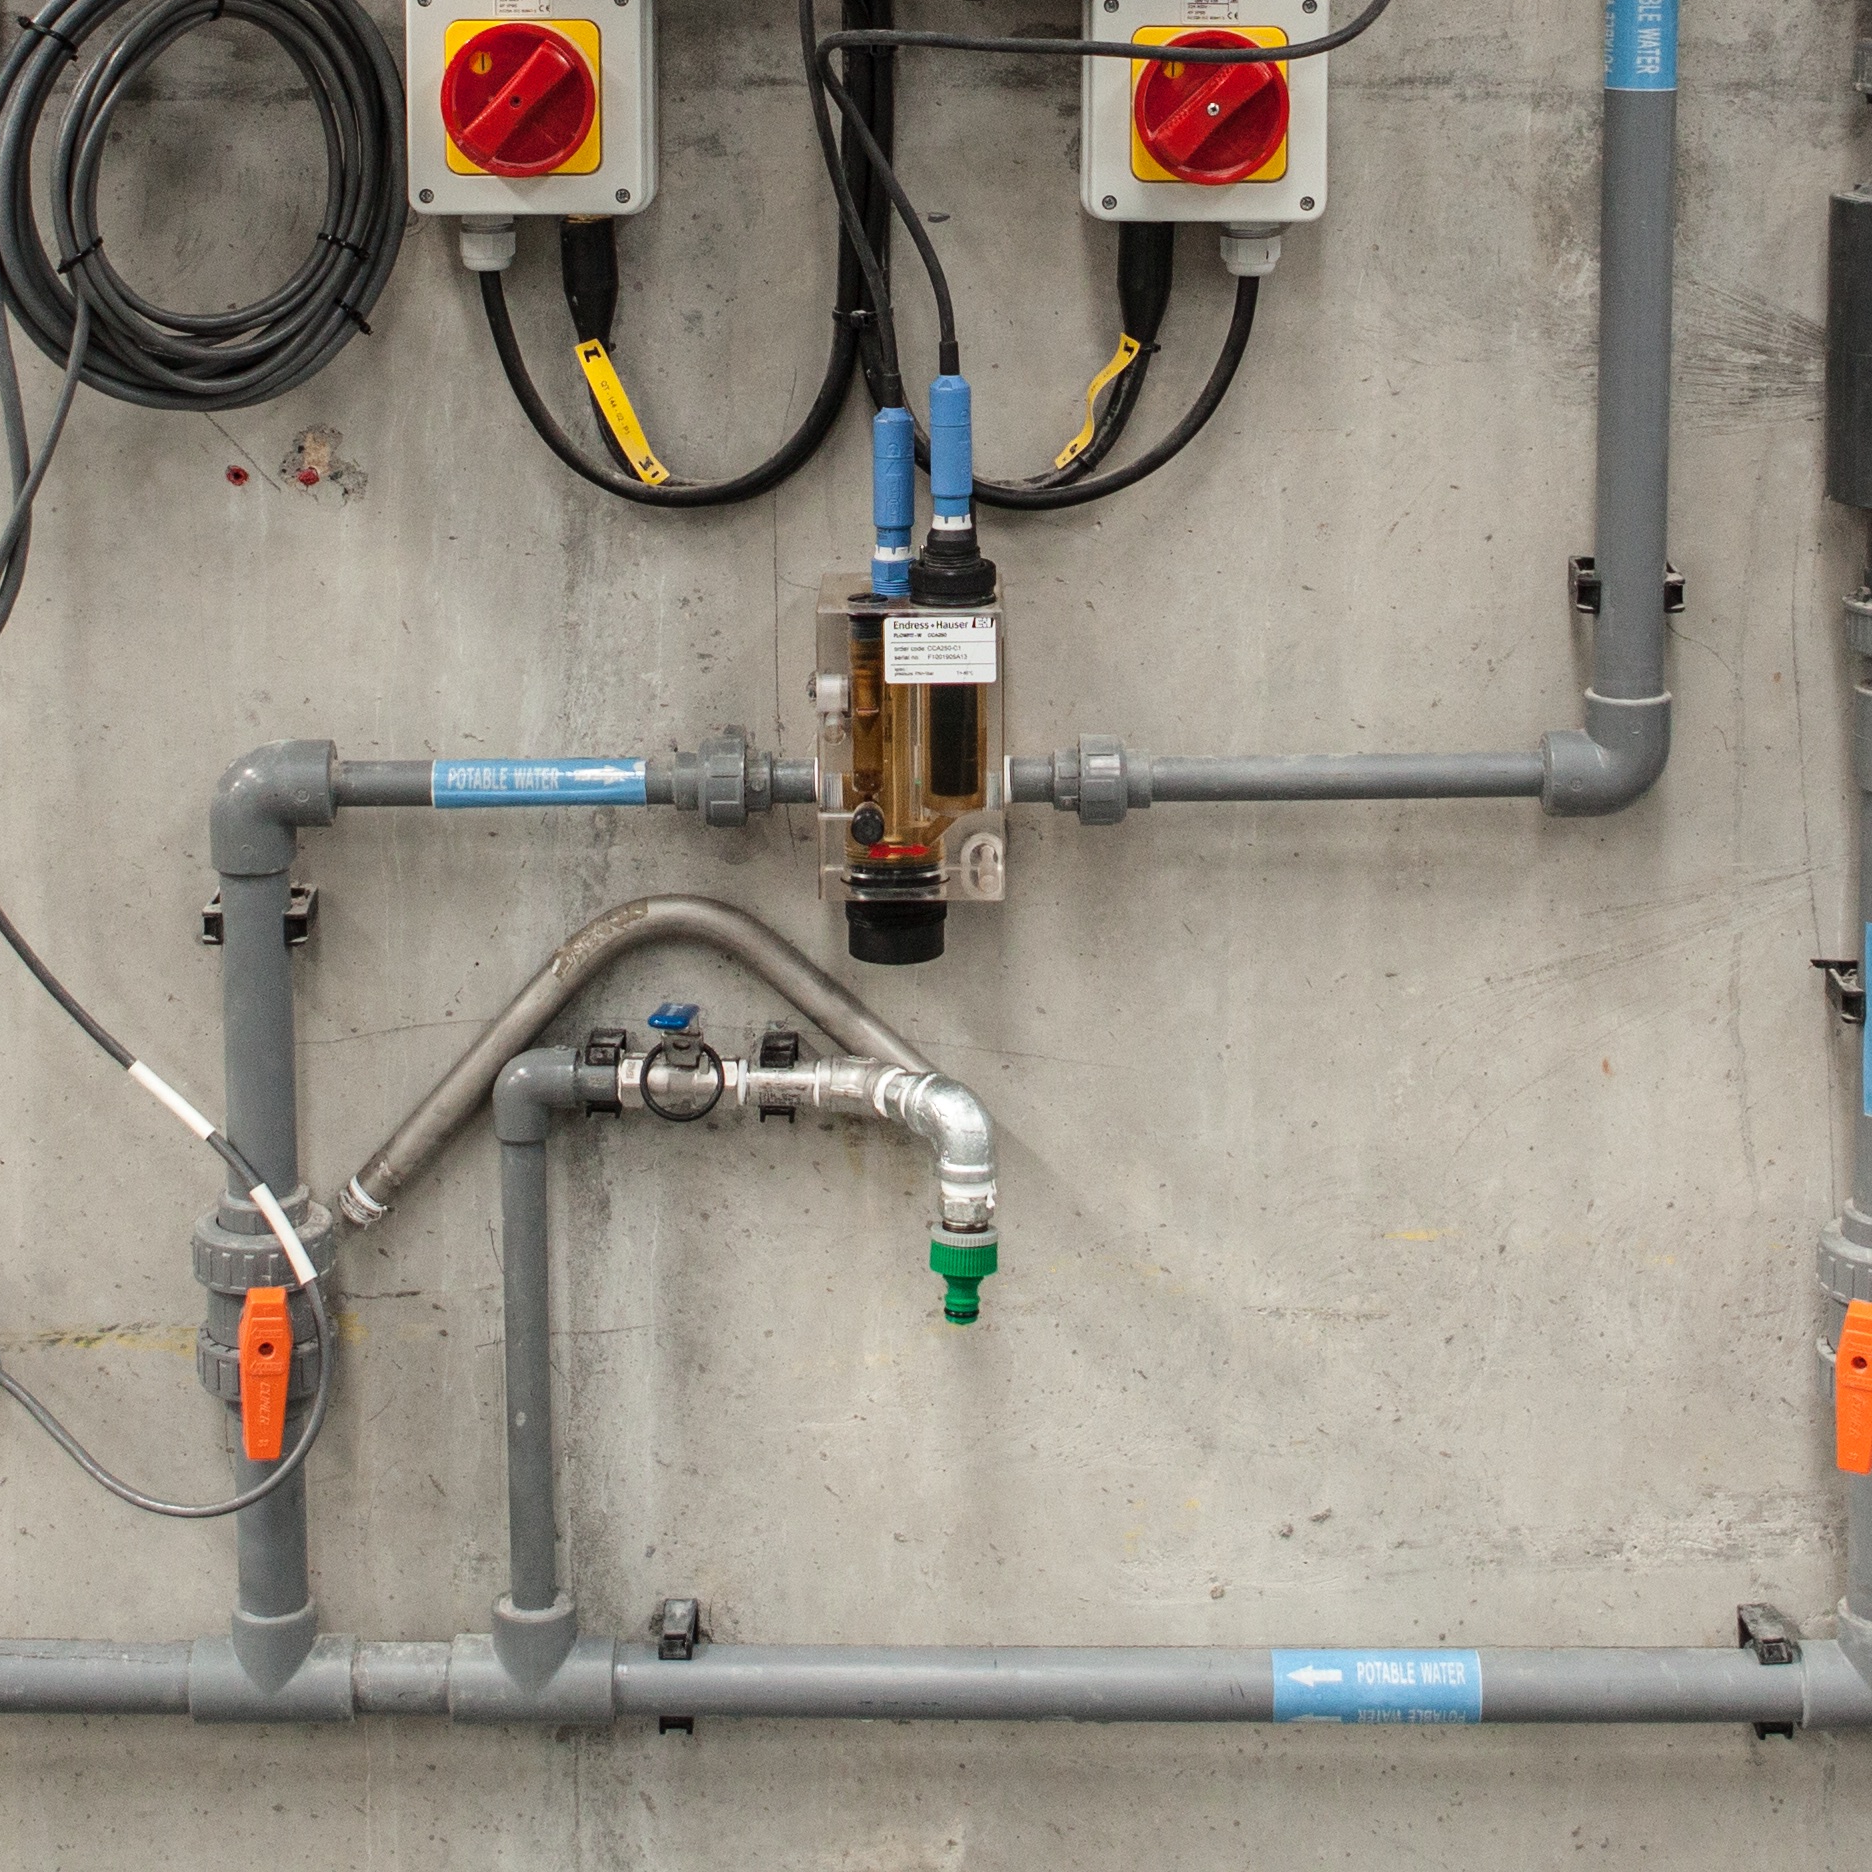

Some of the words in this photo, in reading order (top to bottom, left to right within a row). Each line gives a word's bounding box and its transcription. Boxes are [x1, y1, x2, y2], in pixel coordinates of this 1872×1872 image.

[1635, 27, 1661, 75] WATER
[447, 766, 508, 790] POTABLE
[514, 766, 559, 790] WATER
[1357, 1661, 1416, 1684] POTABLE
[1420, 1661, 1466, 1685] WATER
